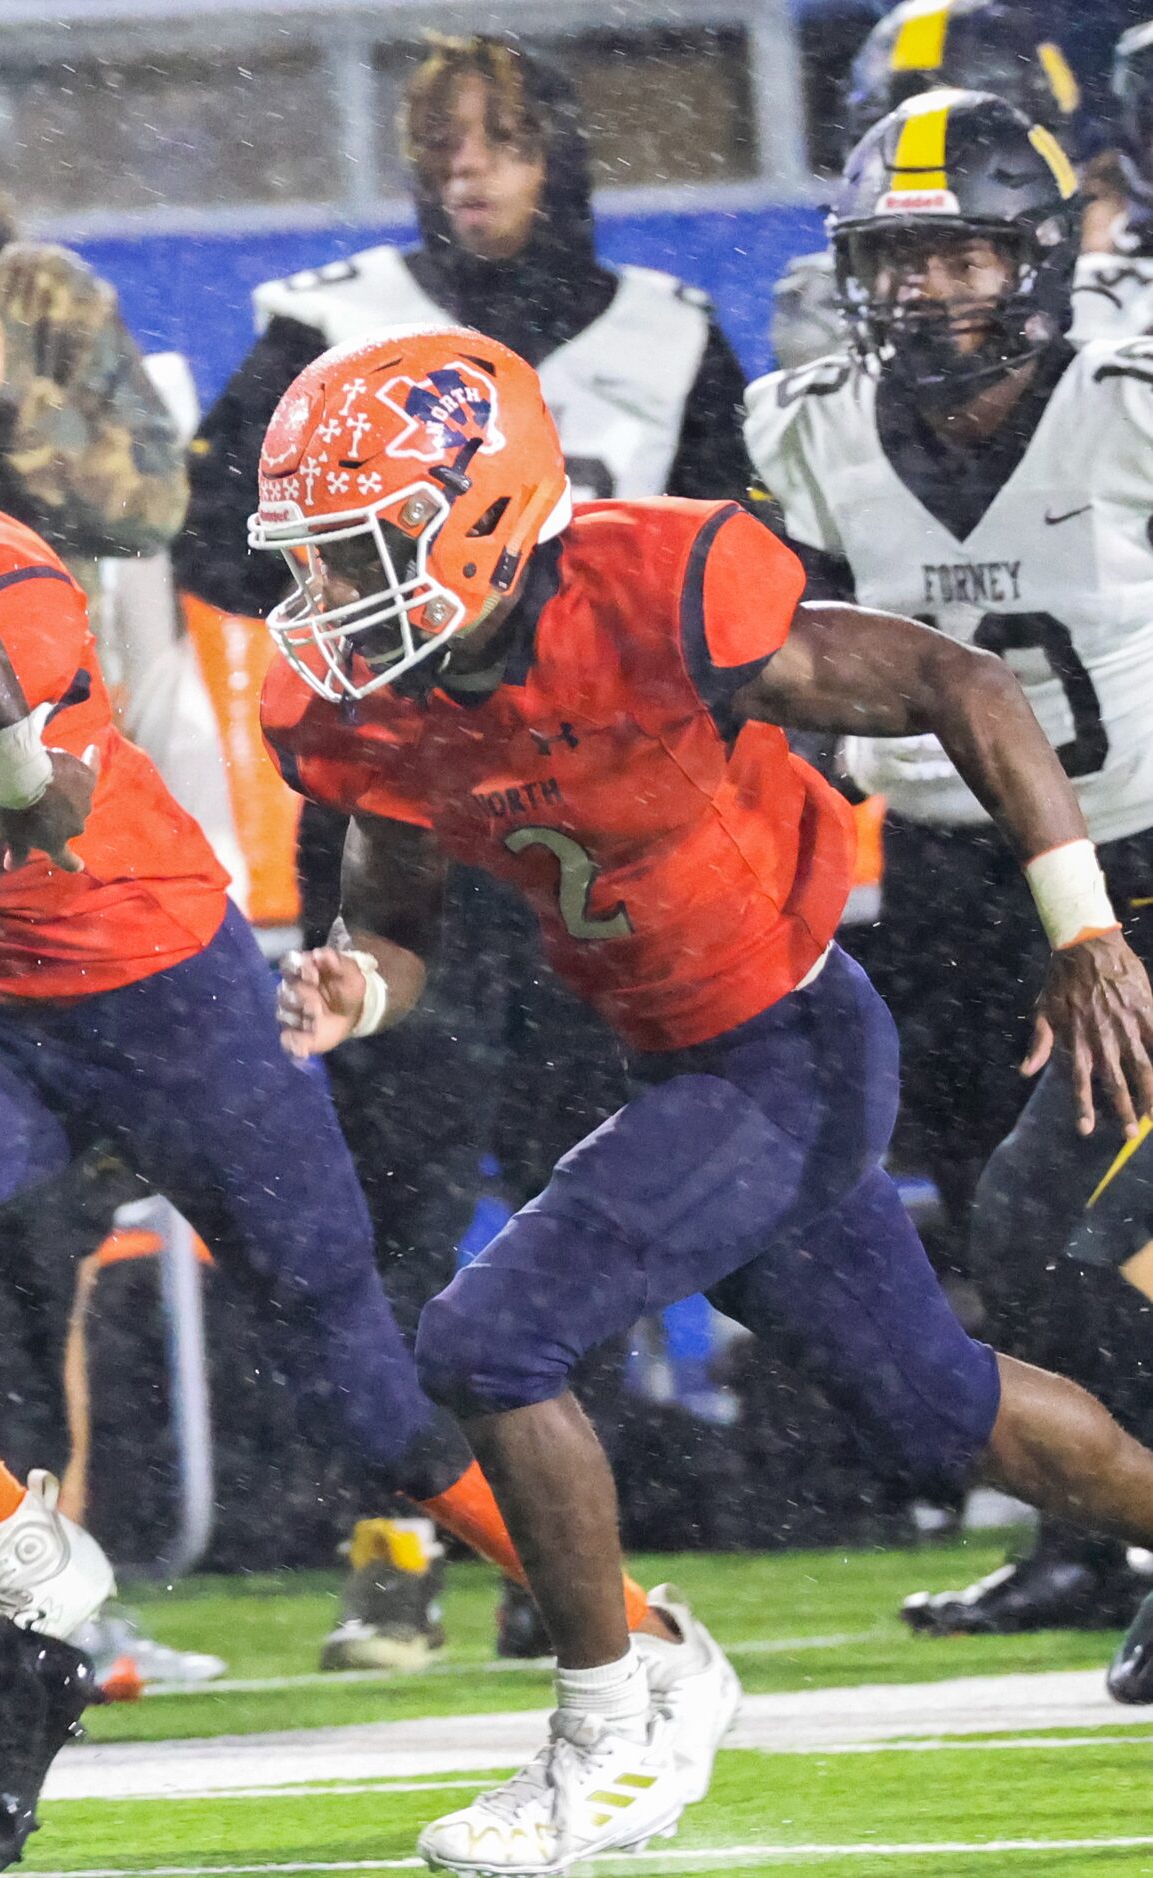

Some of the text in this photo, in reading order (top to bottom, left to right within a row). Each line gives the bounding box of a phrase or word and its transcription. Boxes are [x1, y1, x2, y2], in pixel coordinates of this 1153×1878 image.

[426, 386, 482, 450] NORTH
[921, 561, 1021, 602] FORNEY
[504, 825, 635, 941] 2
